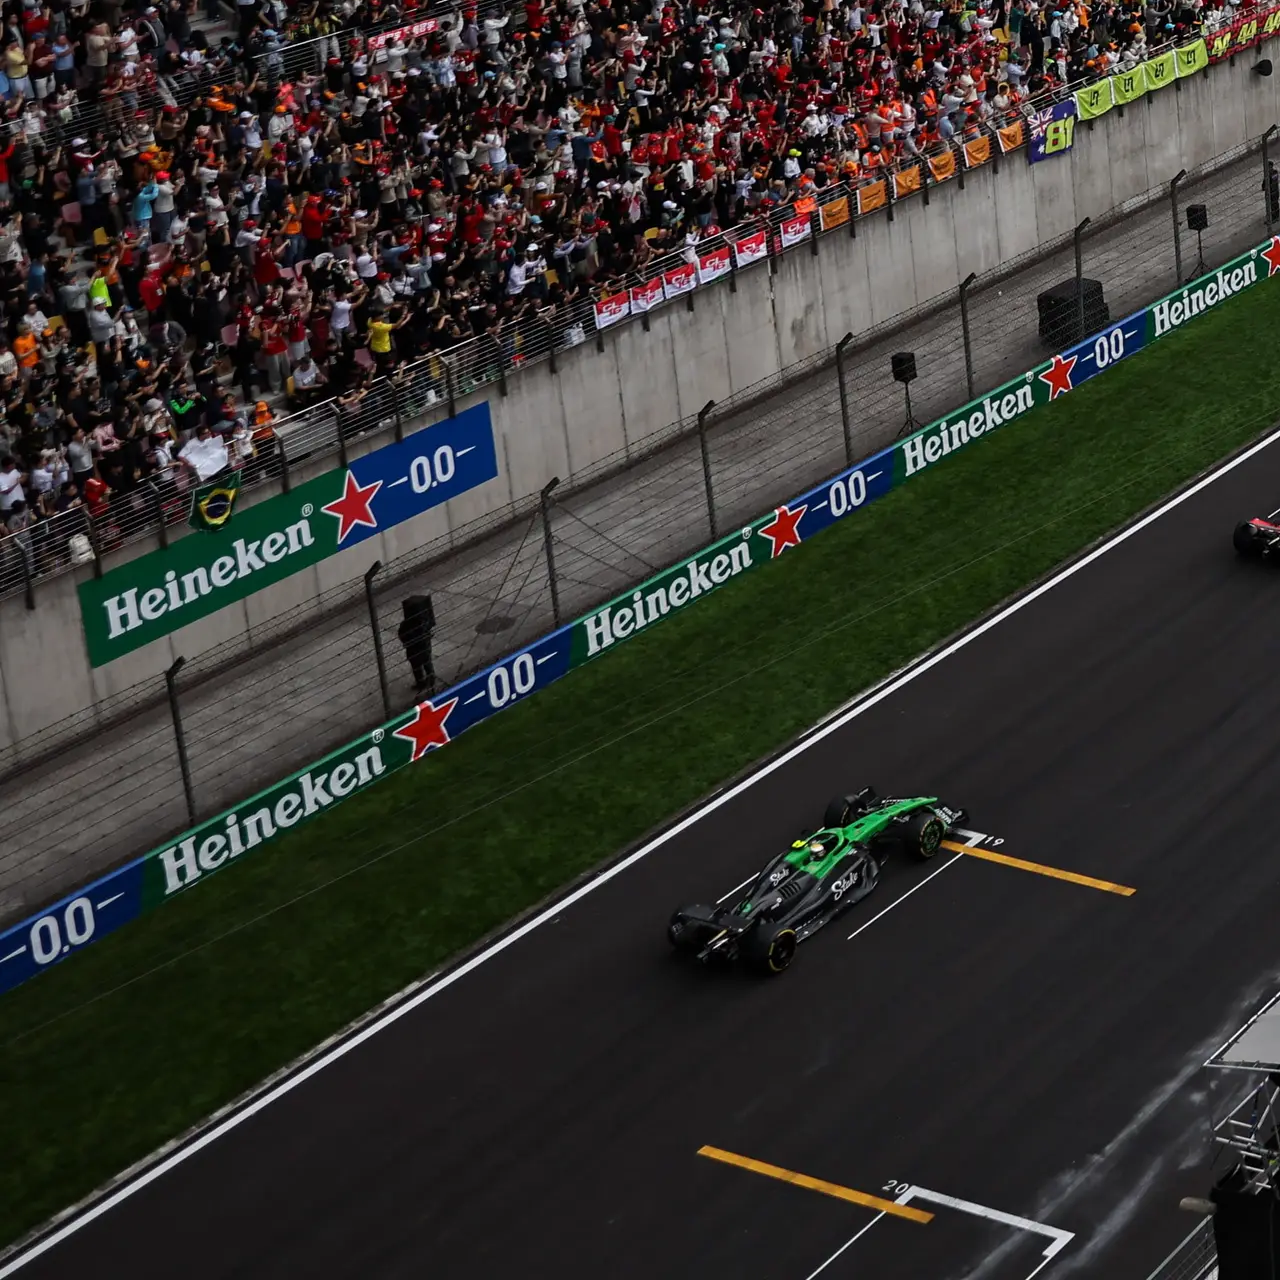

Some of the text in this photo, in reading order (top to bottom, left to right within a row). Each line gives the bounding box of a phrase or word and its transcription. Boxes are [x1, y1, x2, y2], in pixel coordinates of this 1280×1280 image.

[1237, 20, 1257, 45] 44
[1044, 115, 1073, 154] 81
[1152, 259, 1257, 337] Heineken
[903, 381, 1034, 477] Heineken
[104, 445, 455, 640] Heineken 0.0
[584, 471, 866, 656] Heineken 0.0
[158, 653, 535, 895] Heineken 0.0
[30, 896, 95, 965] 0.0
[882, 1179, 909, 1195] 20
